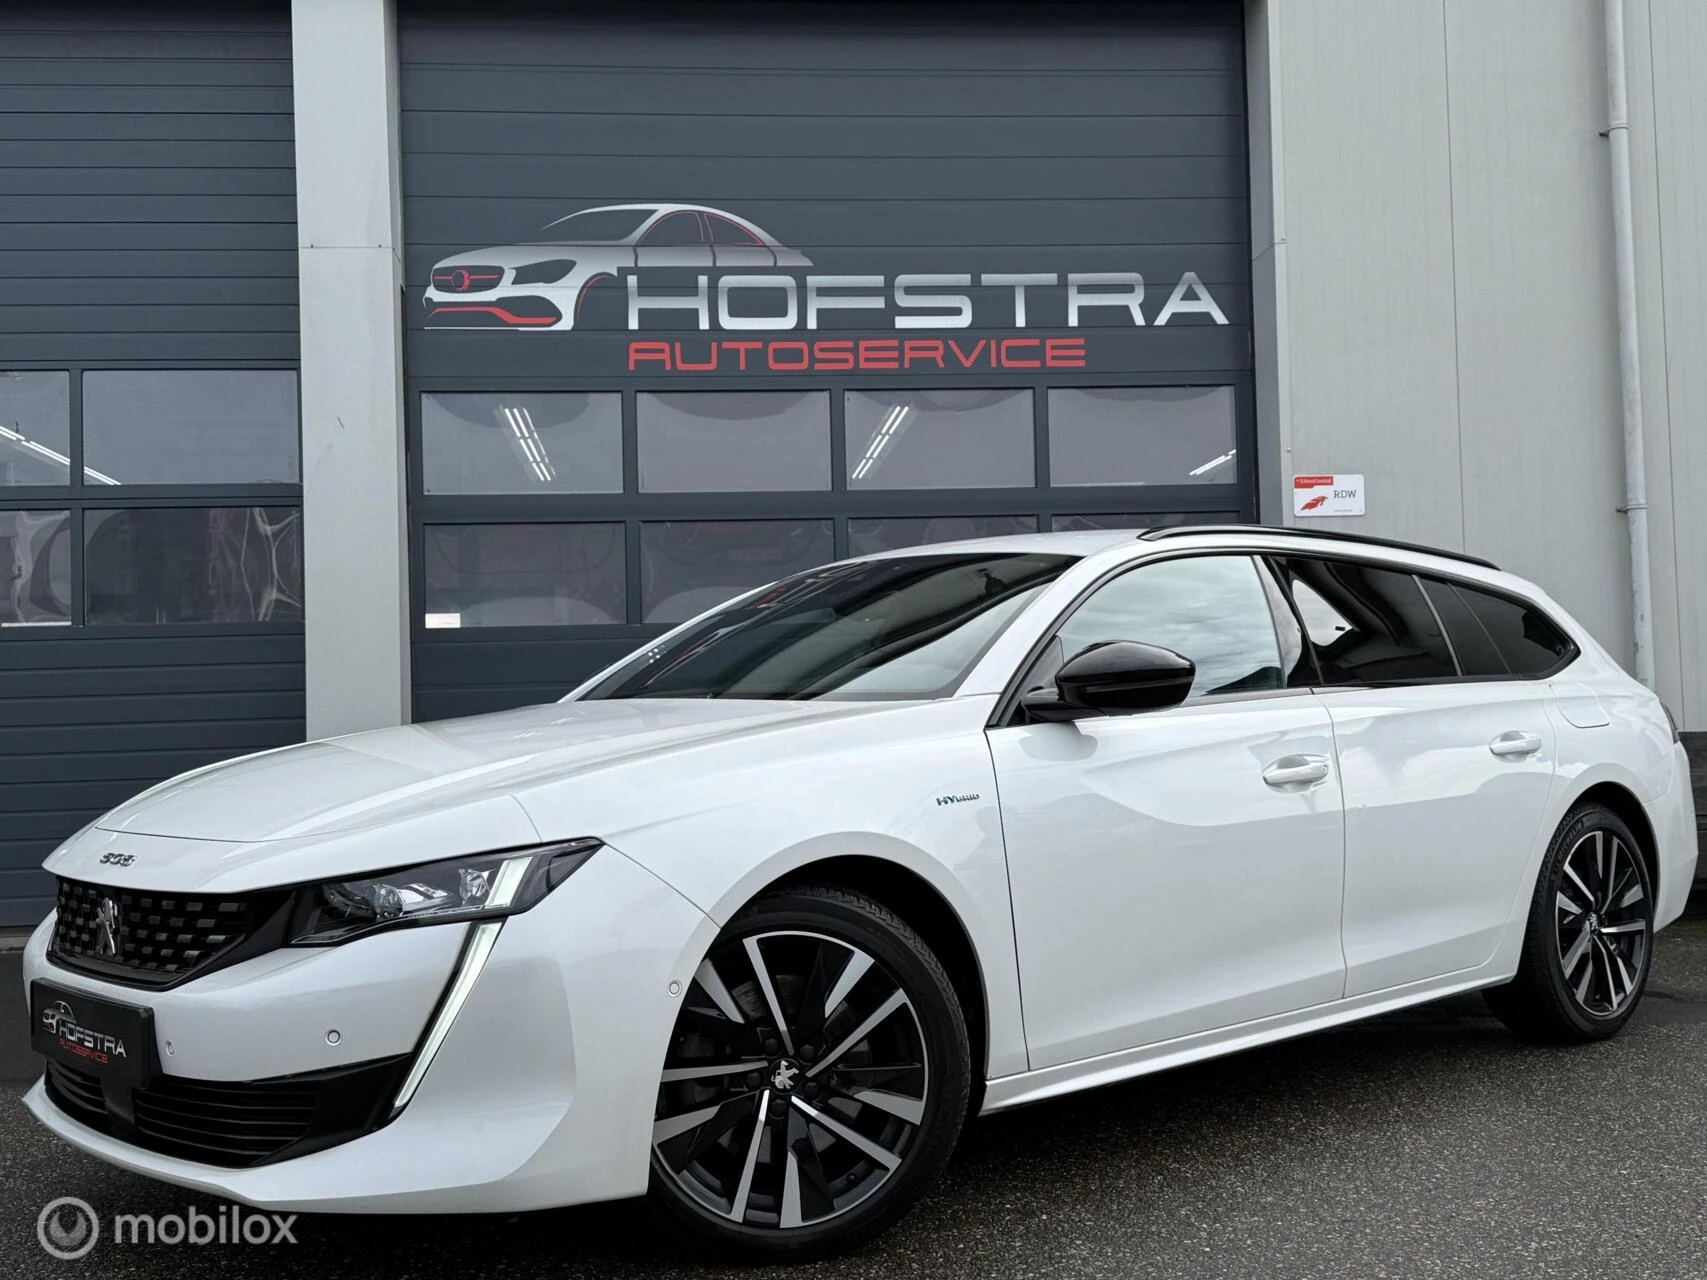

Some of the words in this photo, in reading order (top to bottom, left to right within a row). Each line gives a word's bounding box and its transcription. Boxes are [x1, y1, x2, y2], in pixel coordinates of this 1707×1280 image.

[626, 271, 1230, 331] HOFSTRA
[628, 338, 1087, 371] AUTOSERVICE
[1333, 489, 1357, 499] RDW
[59, 1019, 127, 1058] HOFSTRA
